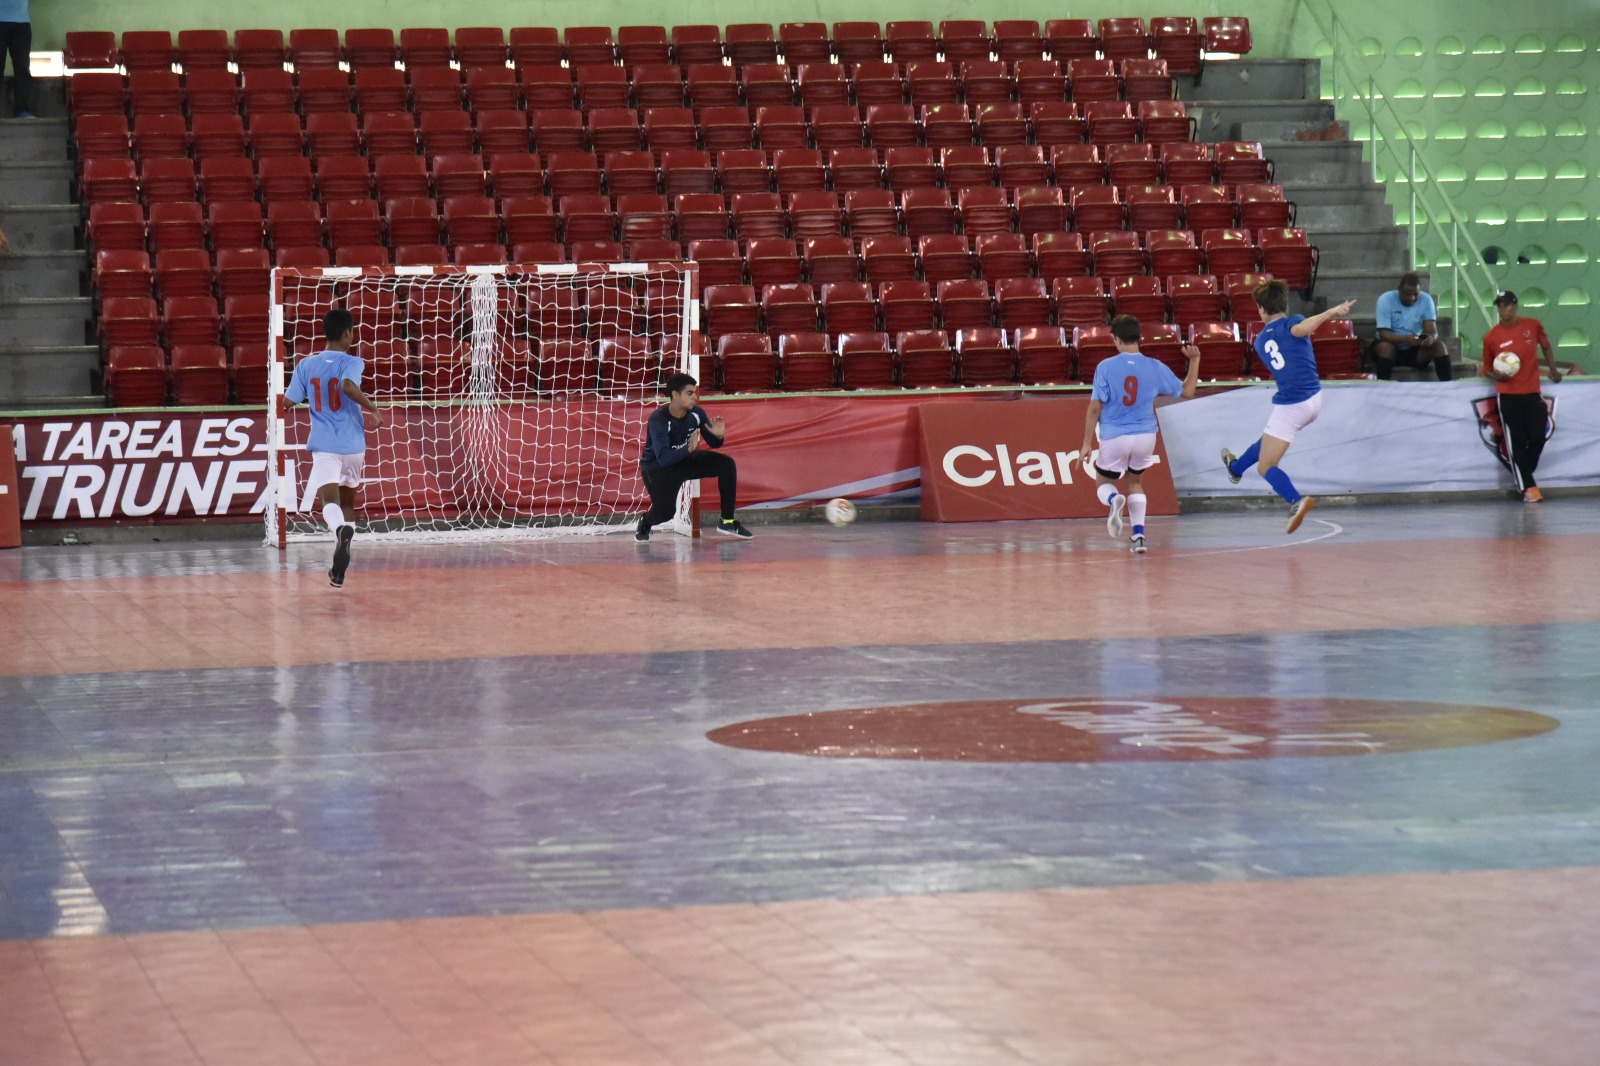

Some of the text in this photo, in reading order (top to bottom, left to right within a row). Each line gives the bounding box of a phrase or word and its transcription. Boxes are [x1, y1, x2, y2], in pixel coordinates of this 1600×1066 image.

[1264, 339, 1285, 370] 3
[310, 378, 342, 413] 10
[1123, 375, 1139, 407] 9
[42, 420, 183, 461] TAREA
[192, 418, 255, 458] ES
[22, 459, 319, 520] TRIUNFA
